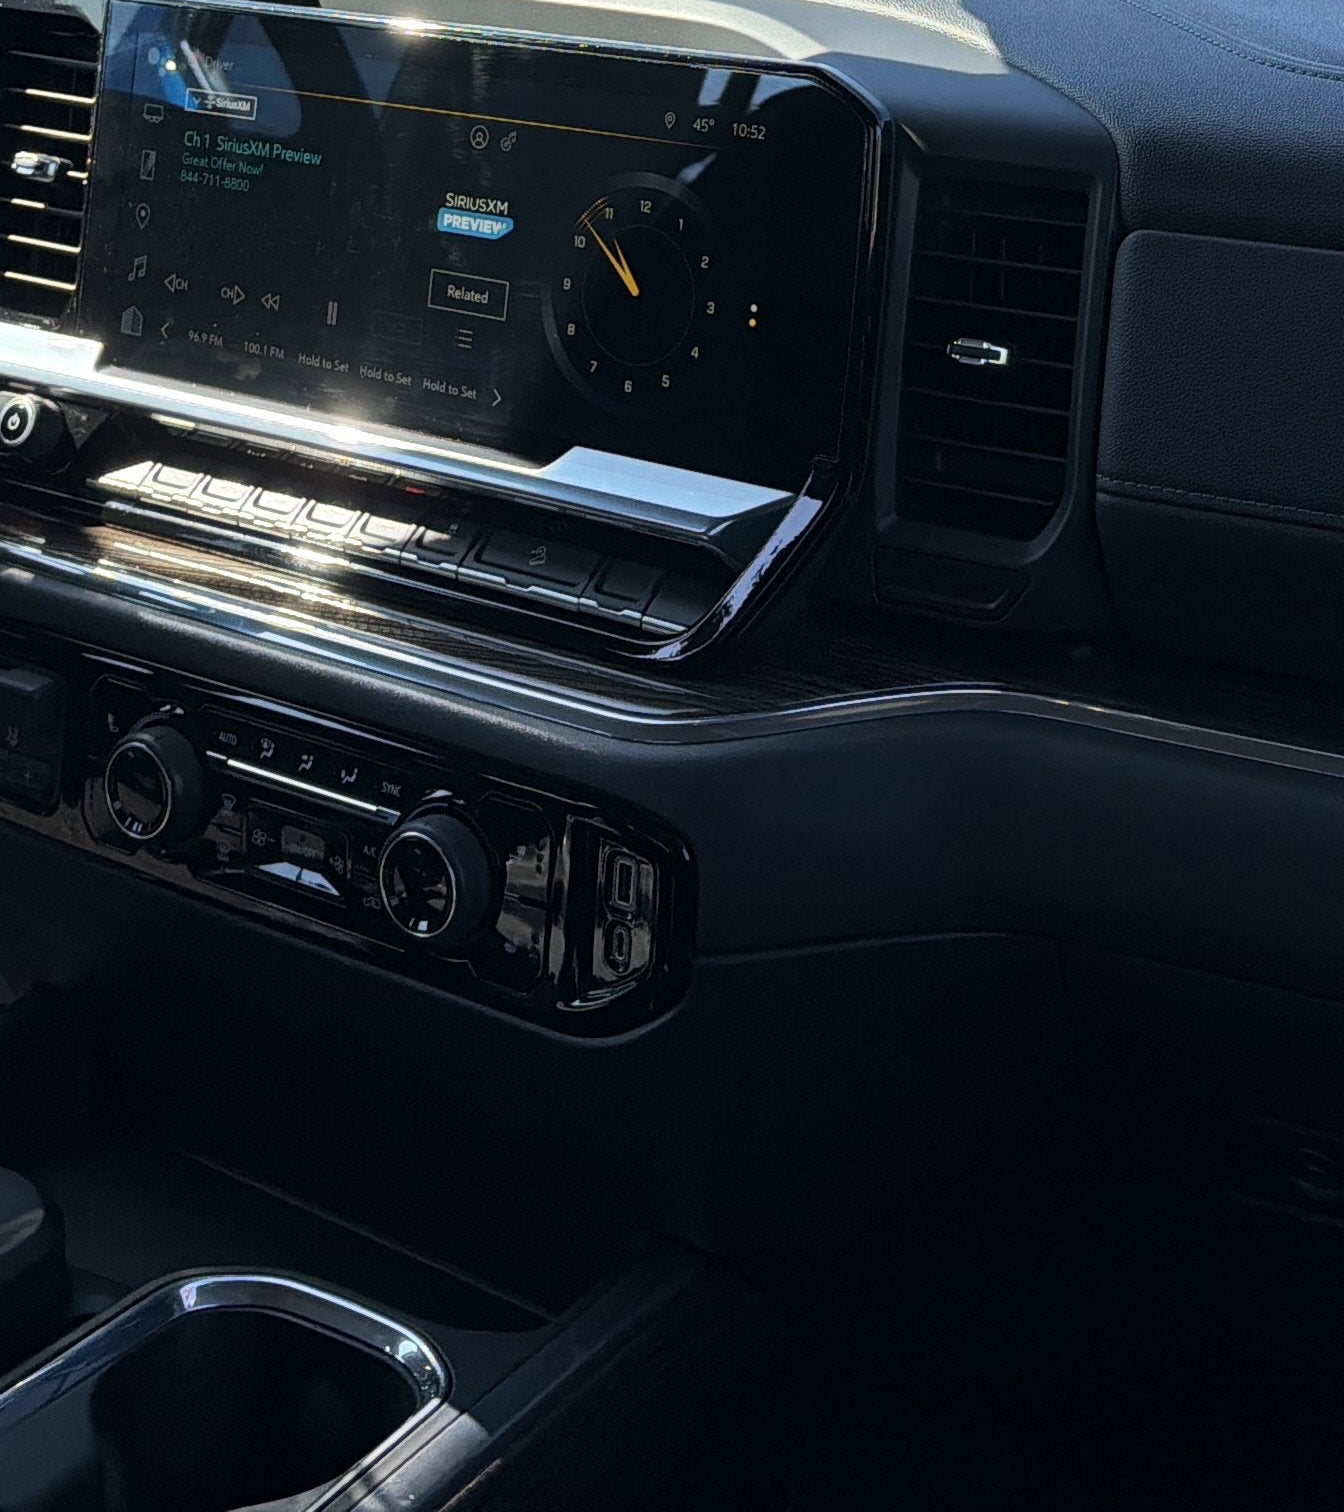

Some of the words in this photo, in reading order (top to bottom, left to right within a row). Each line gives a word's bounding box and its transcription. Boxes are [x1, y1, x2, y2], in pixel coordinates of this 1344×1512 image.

[206, 56, 235, 70] Driver
[216, 98, 251, 112] SiriusXM
[692, 117, 715, 133] 45°
[732, 122, 766, 140] 10:52
[184, 131, 200, 148] Ch
[203, 134, 210, 149] 1
[216, 136, 270, 159] SiriusXM
[273, 144, 323, 166] Preview
[182, 153, 209, 168] Great
[211, 157, 237, 172] Offer
[239, 162, 264, 176] Now!
[180, 170, 250, 192] 844-711-8800
[445, 192, 509, 216] SIRIUSXM
[640, 200, 652, 213] 12
[605, 208, 614, 220] 11
[443, 213, 507, 234] PREVIEW
[574, 235, 586, 248] 10
[701, 255, 709, 268] 2
[175, 278, 188, 291] CH
[563, 278, 571, 290] 9
[221, 287, 233, 300] CH
[447, 285, 489, 304] Related
[706, 301, 715, 314] 3
[567, 323, 575, 335] 8
[188, 329, 208, 344] 96.9
[209, 335, 223, 347] FM
[244, 341, 268, 357] 100.1
[270, 347, 285, 360] FM
[691, 346, 699, 359] 4
[298, 352, 320, 368] Hold
[322, 358, 333, 370] to
[335, 359, 349, 373] Set
[590, 360, 598, 373] 7
[360, 365, 381, 380] Hold
[383, 370, 394, 382] to
[395, 372, 412, 386] Set
[662, 375, 670, 387] 5
[423, 378, 445, 394] Hold
[448, 384, 458, 396] to
[461, 386, 477, 400] Set
[624, 380, 632, 393] 6
[219, 731, 238, 746] AUTO
[382, 781, 402, 797] SYNC
